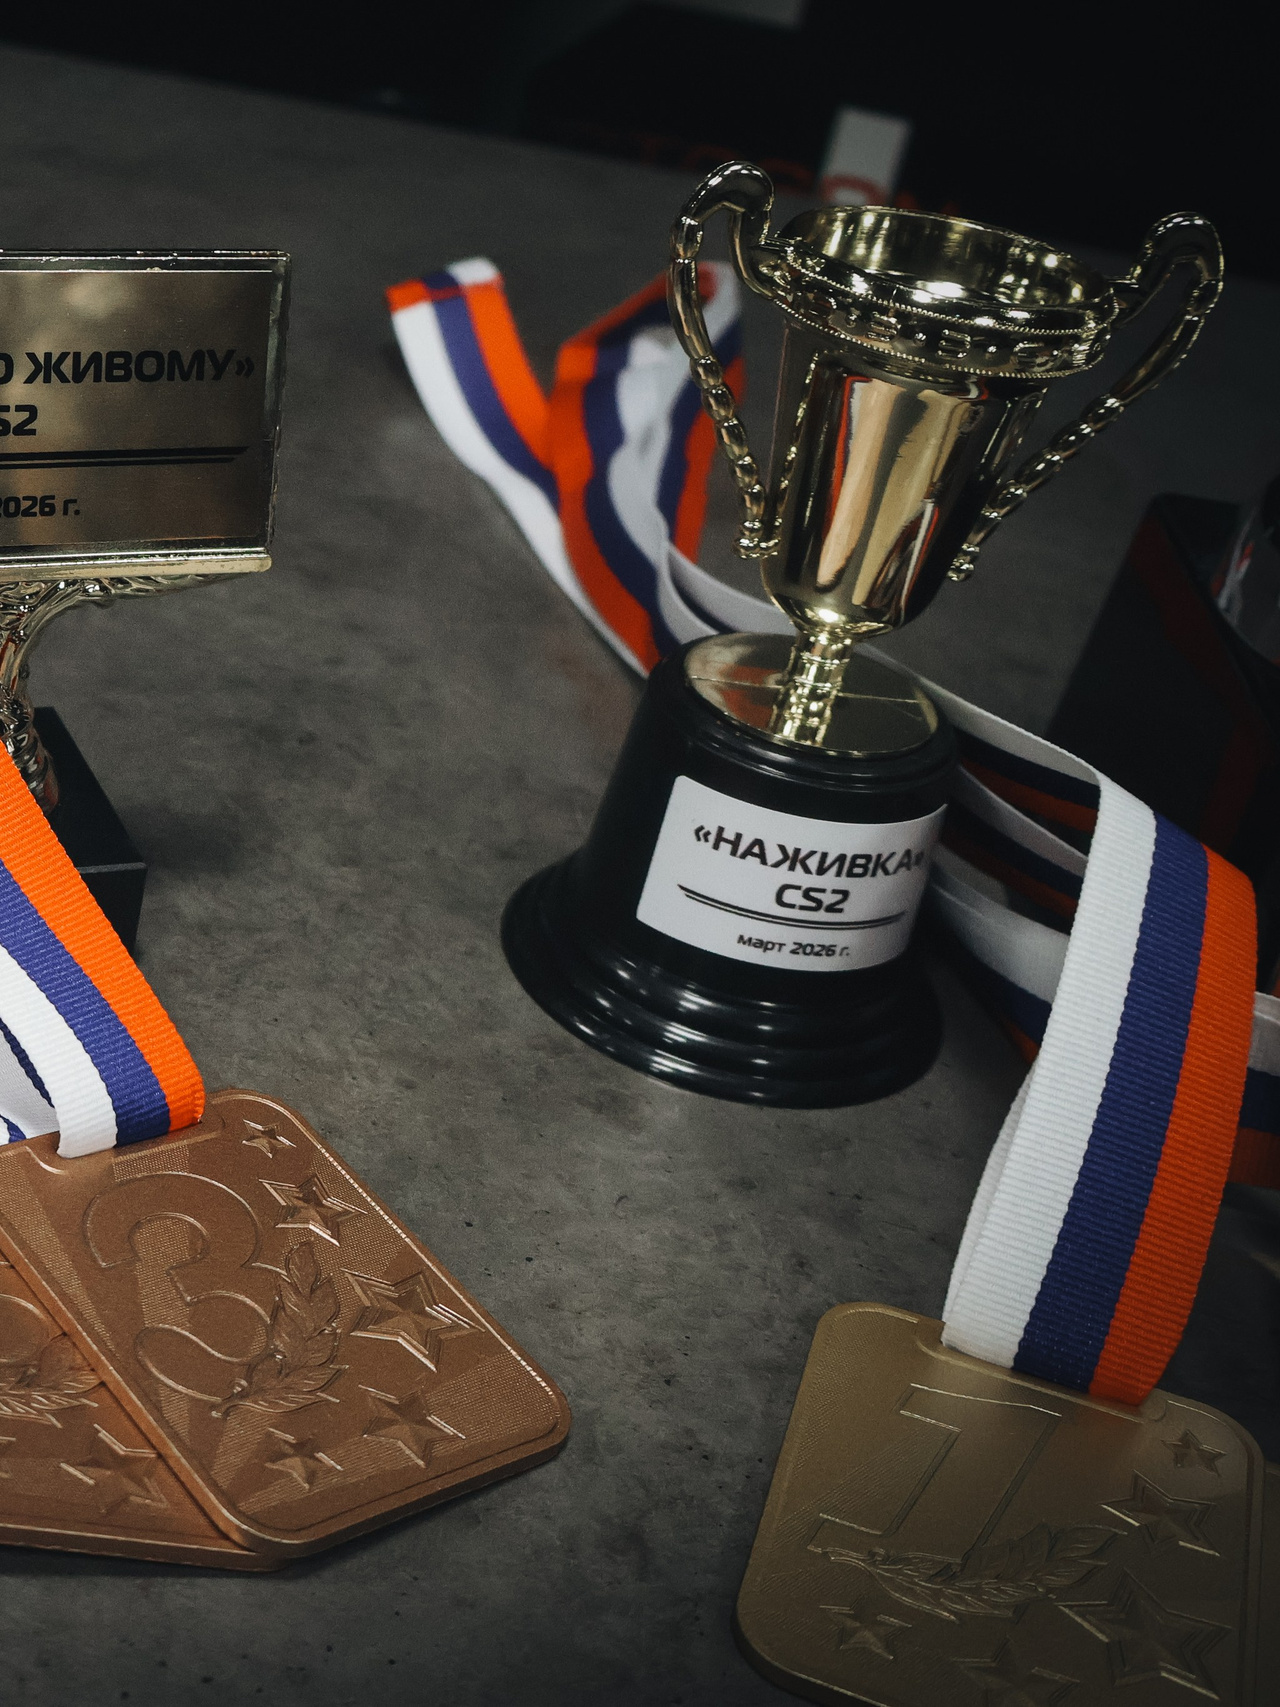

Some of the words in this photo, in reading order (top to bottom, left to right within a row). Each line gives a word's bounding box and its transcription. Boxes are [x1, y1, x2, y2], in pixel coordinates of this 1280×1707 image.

[24, 348, 255, 384] ЖИВОМУ»
[61, 499, 81, 516] г.
[775, 883, 850, 914] CS2
[737, 933, 786, 954] март
[790, 941, 836, 957] 2026
[839, 945, 851, 957] г.
[82, 1170, 290, 1400] 3
[806, 1382, 1062, 1564] 1
